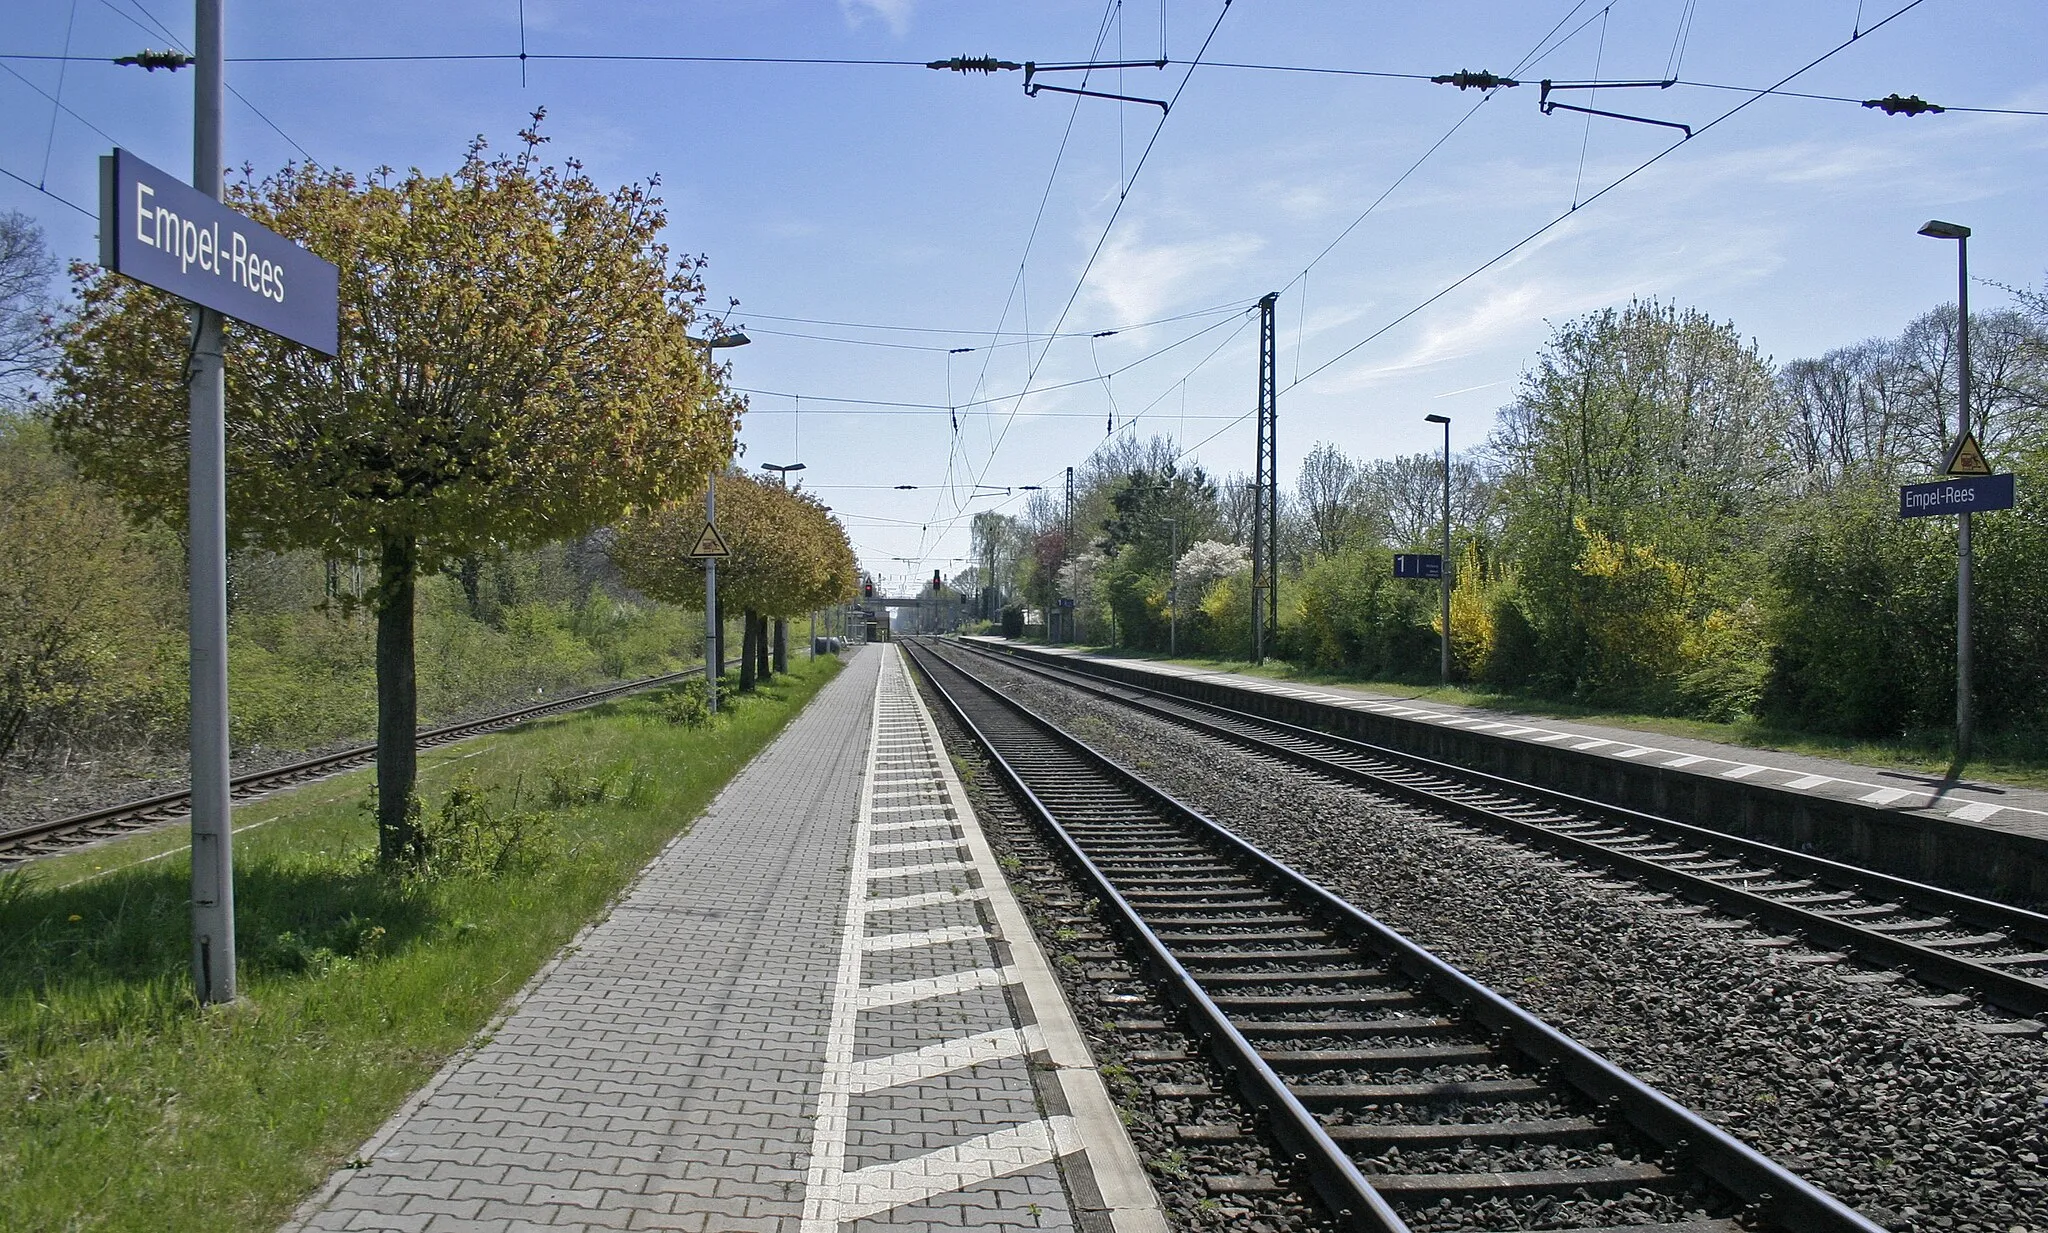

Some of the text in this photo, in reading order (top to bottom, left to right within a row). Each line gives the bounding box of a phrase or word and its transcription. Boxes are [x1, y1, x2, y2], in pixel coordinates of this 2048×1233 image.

[136, 182, 284, 303] Empel-Rees
[1906, 486, 1975, 511] Empel-Rees
[1397, 555, 1405, 573] 1
